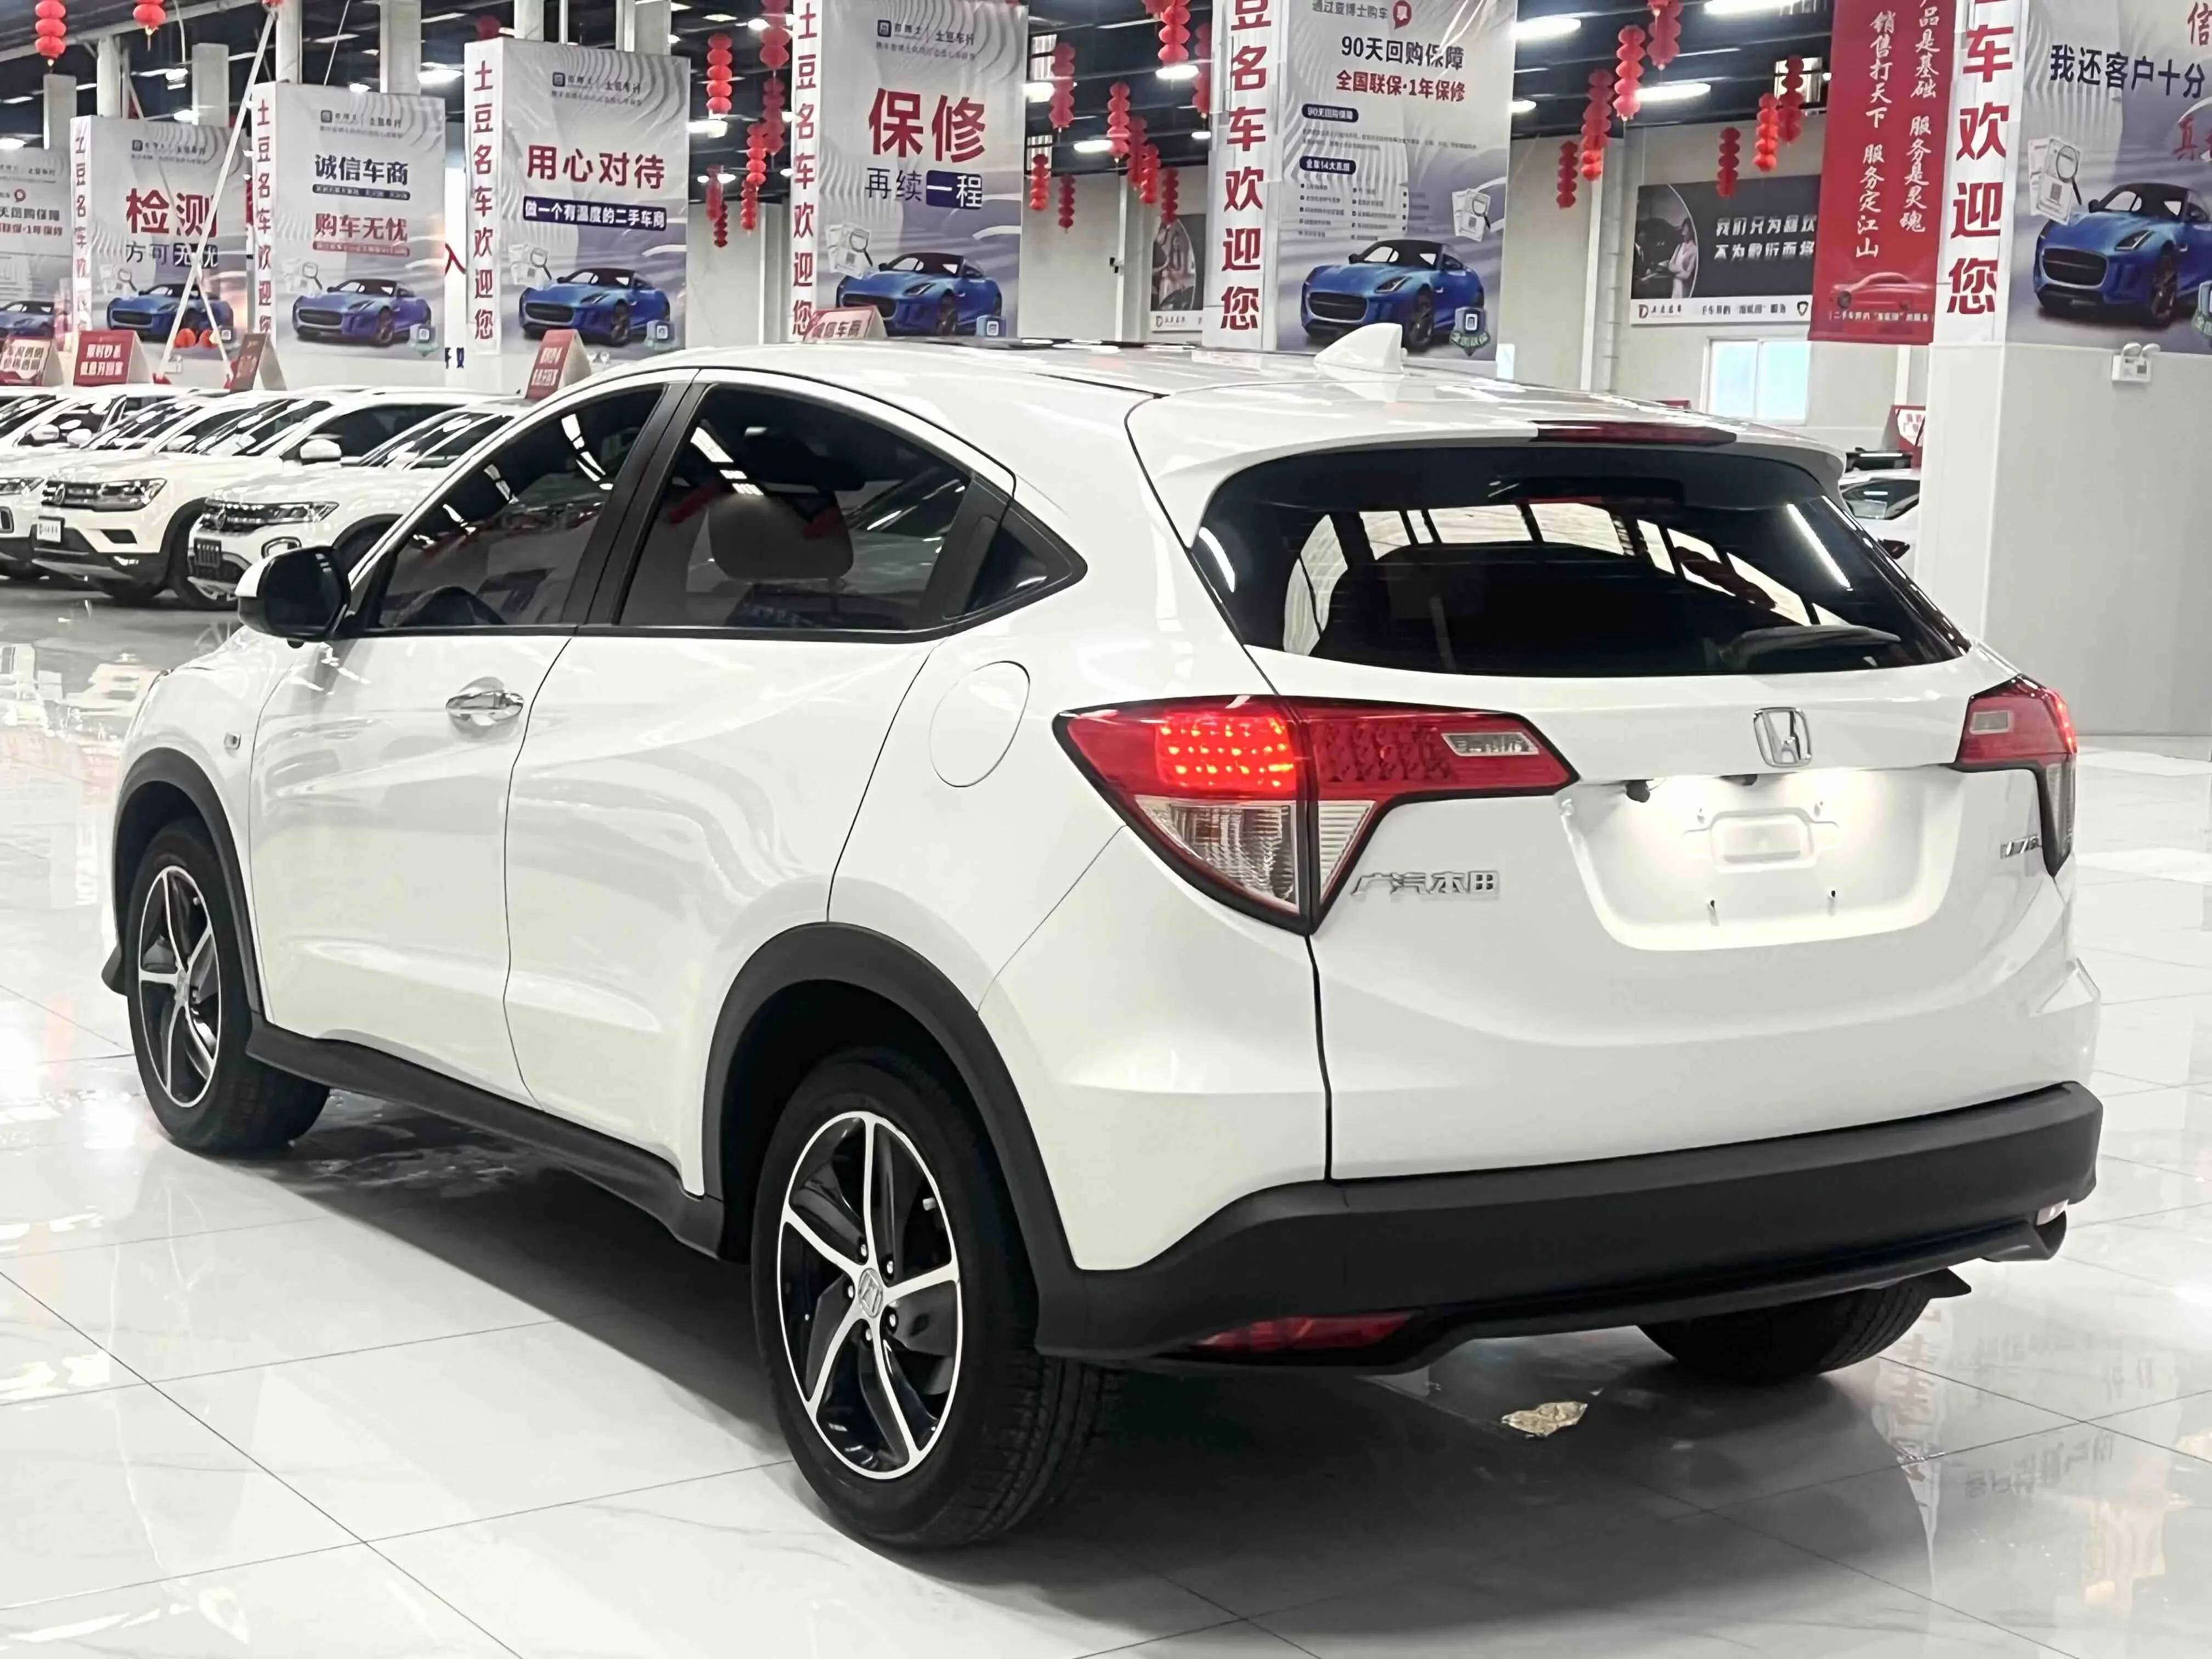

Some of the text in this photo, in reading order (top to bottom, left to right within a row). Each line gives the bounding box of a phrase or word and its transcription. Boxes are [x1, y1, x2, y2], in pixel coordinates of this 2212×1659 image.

[1341, 36, 1464, 70] 90天回购保障
[1910, 0, 1940, 99] 品是基础
[2050, 44, 2205, 98] 我还客户十分
[868, 88, 985, 163] 保修
[1856, 10, 1897, 258] 销售打天下 服务定江山
[2172, 116, 2212, 161] 真
[314, 154, 409, 185] 诚信车商
[527, 144, 665, 189] 用心对待
[792, 3, 818, 336] 土豆名车欢迎您
[1220, 0, 1272, 330] 豆名车欢迎您
[1946, 0, 2014, 315] 车欢迎您
[126, 188, 218, 238] 检测
[473, 60, 493, 340] 土豆名车欢迎您
[864, 167, 983, 207] 再续一程
[314, 213, 408, 242] 购车无忧
[1351, 871, 1500, 895] 广汽本田
